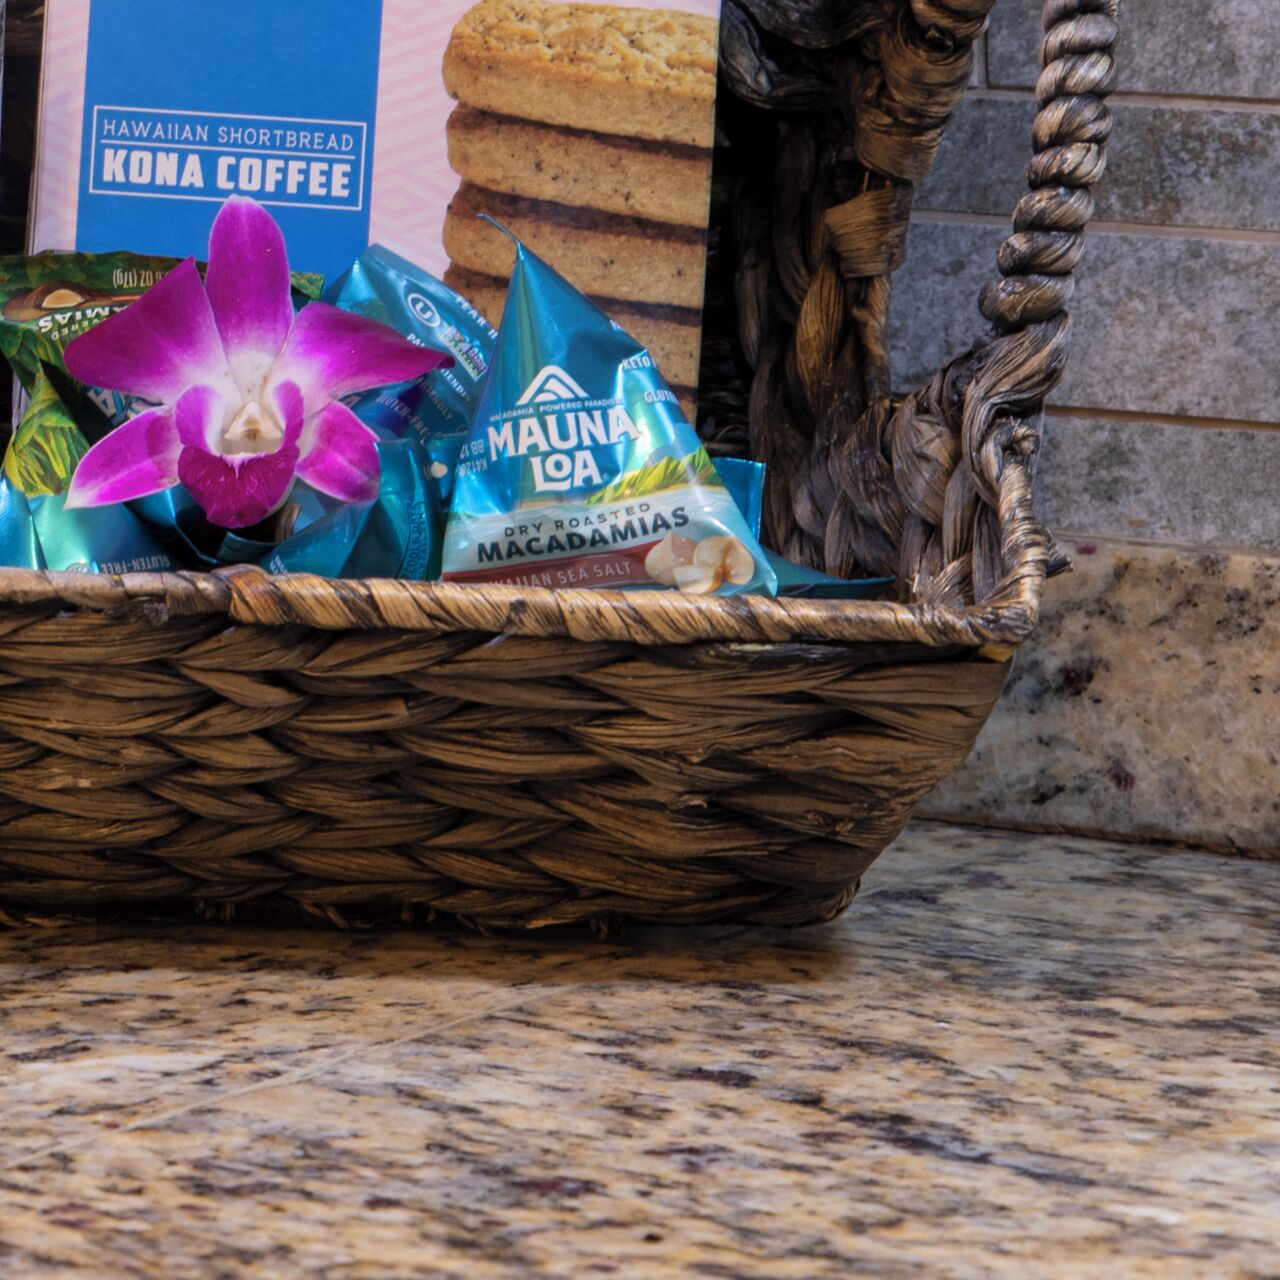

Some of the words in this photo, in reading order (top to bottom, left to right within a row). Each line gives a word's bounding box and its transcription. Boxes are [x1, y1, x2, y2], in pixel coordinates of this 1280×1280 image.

[103, 119, 209, 143] HAWAIIAN
[218, 126, 354, 152] SHORTBREAD
[103, 148, 204, 188] KONA
[216, 156, 352, 197] COFFEE
[113, 268, 138, 289] (17g)
[140, 270, 153, 287] OZ
[623, 357, 651, 371] KETO
[539, 401, 582, 412] POWERED
[487, 408, 641, 462] MAUNA
[529, 449, 604, 492] LOA
[477, 506, 689, 563] MACADAMIAS
[504, 522, 543, 538] DRY
[555, 503, 651, 530] ROASTED
[101, 555, 171, 574] GLUTEN-FREE
[557, 569, 589, 585] SEA
[595, 562, 632, 578] SALT
